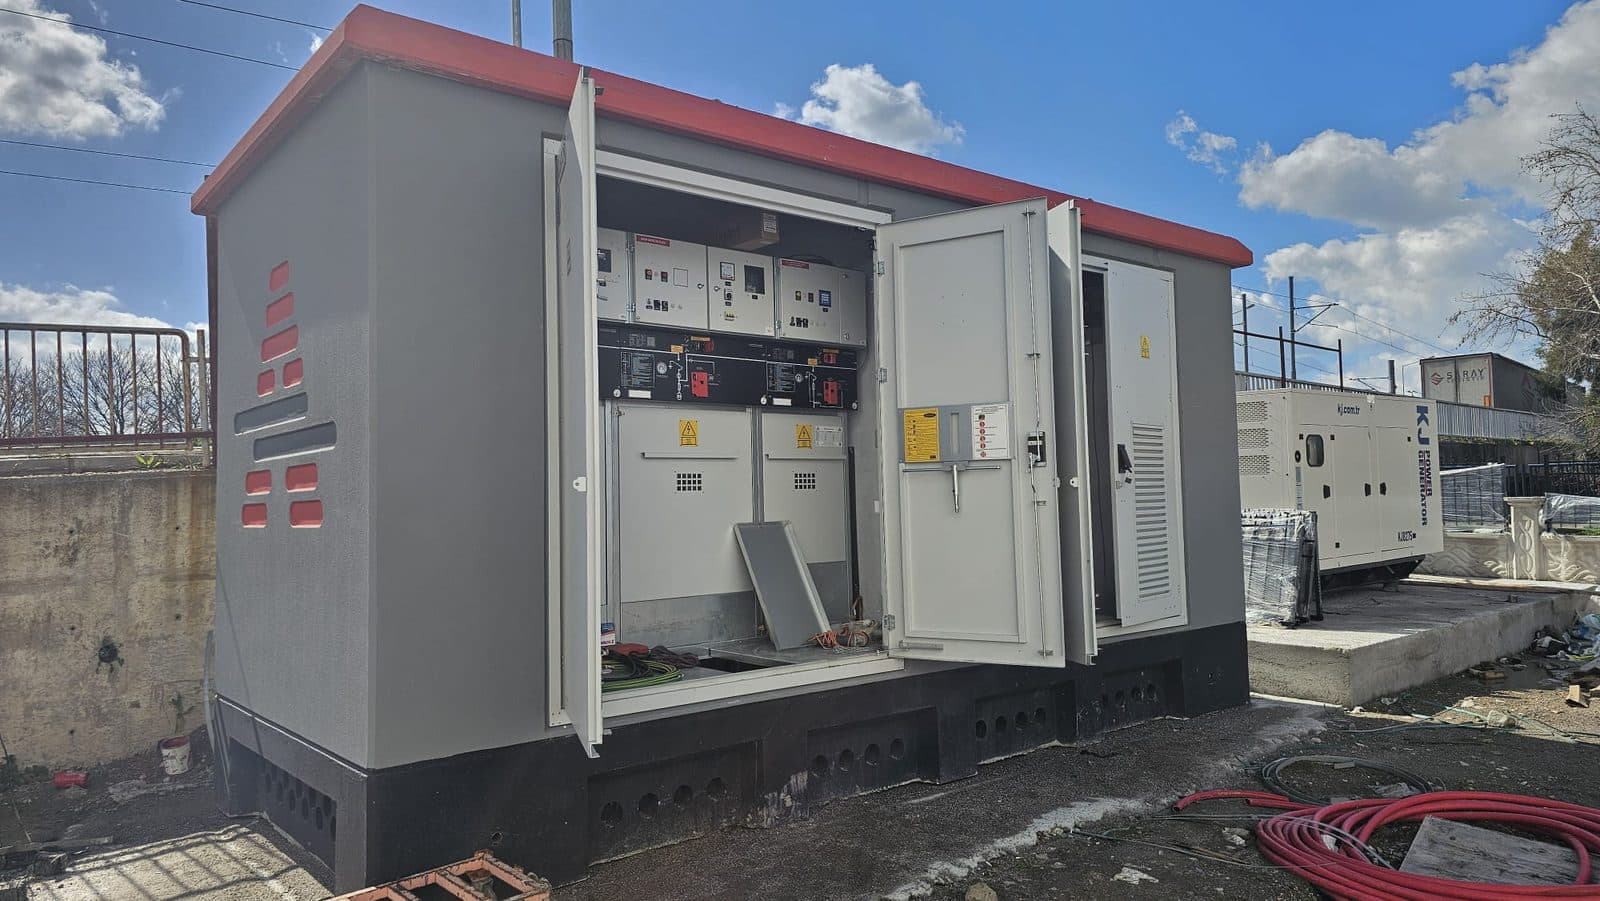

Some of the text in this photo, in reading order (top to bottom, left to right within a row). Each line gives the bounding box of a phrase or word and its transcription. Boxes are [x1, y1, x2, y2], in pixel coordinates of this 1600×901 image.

[1416, 405, 1430, 445] KJ
[1418, 450, 1427, 526] GENERATOR
[1425, 449, 1433, 497] POWER
